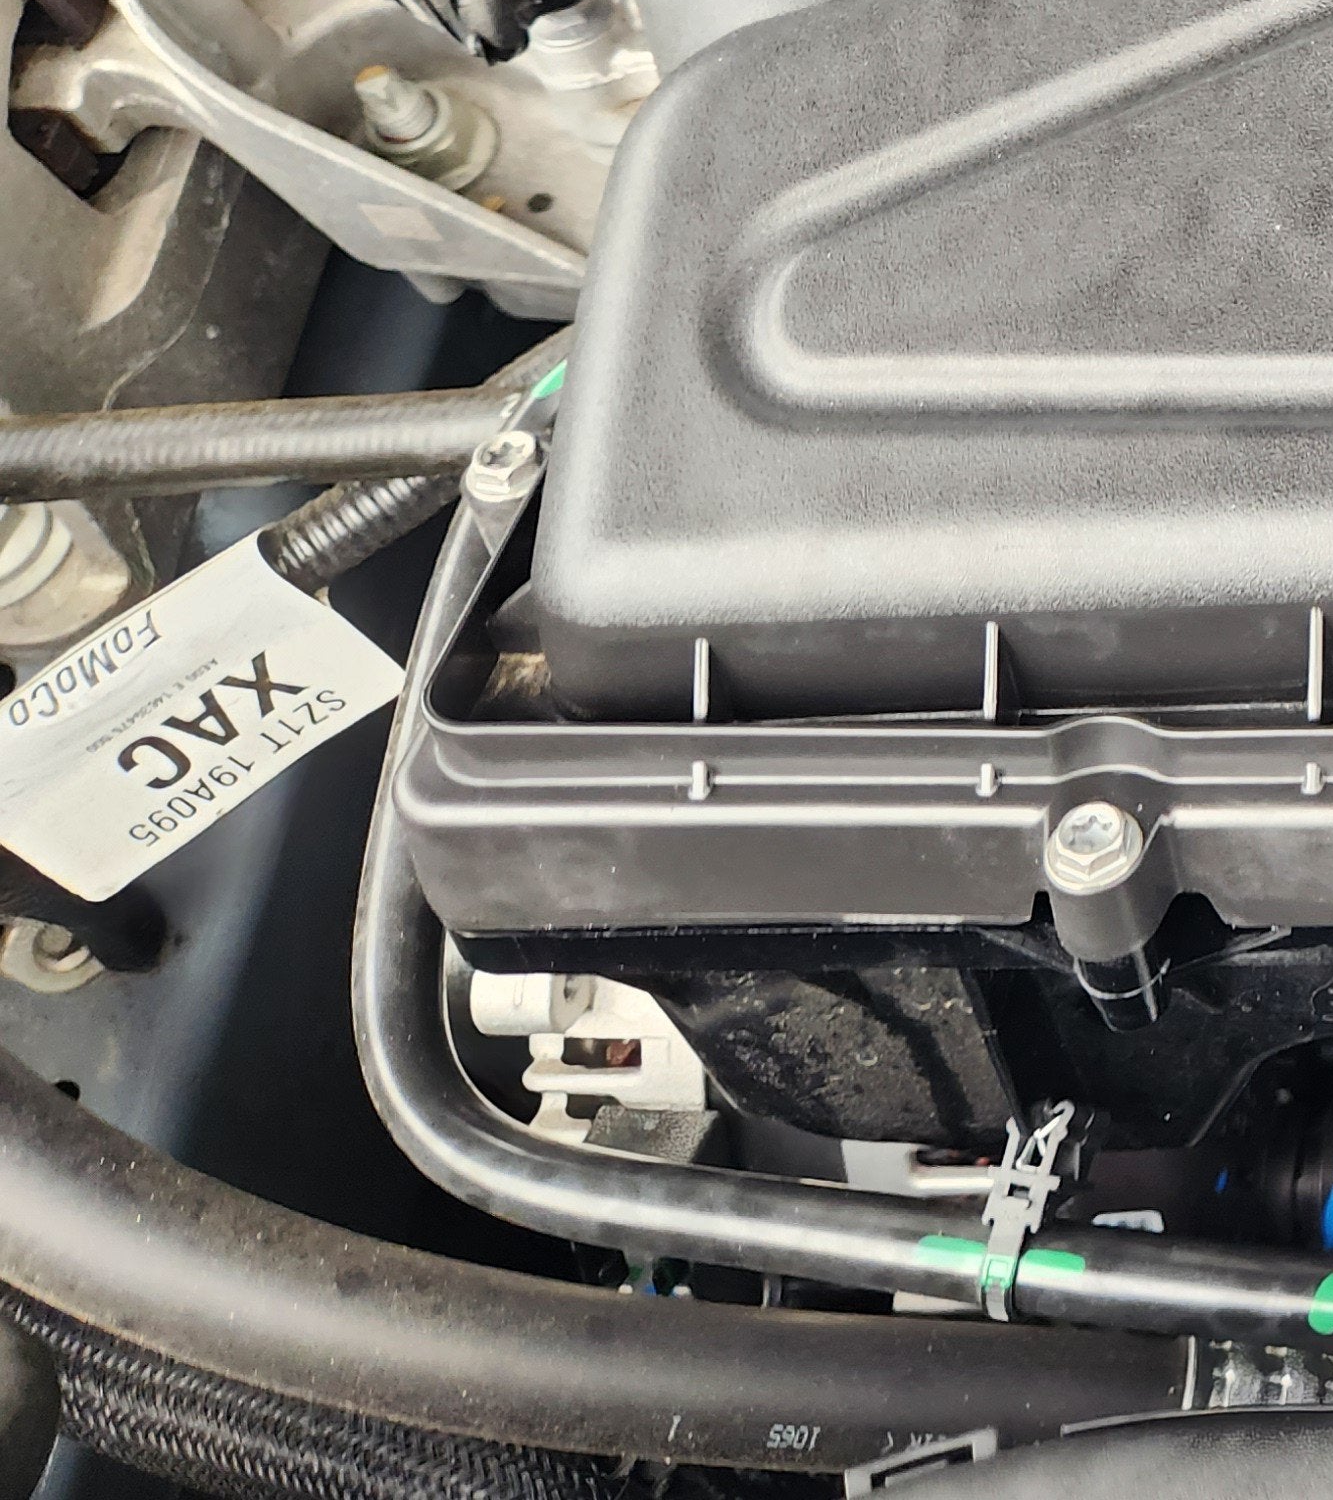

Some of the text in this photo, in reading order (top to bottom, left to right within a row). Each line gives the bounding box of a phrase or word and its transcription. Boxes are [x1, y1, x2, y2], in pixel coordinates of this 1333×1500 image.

[8, 608, 162, 727] FoMoCo
[117, 650, 310, 790] XAC
[260, 689, 347, 754] SZ1T
[129, 755, 256, 848] 19A095
[767, 1424, 821, 1450] 1065
